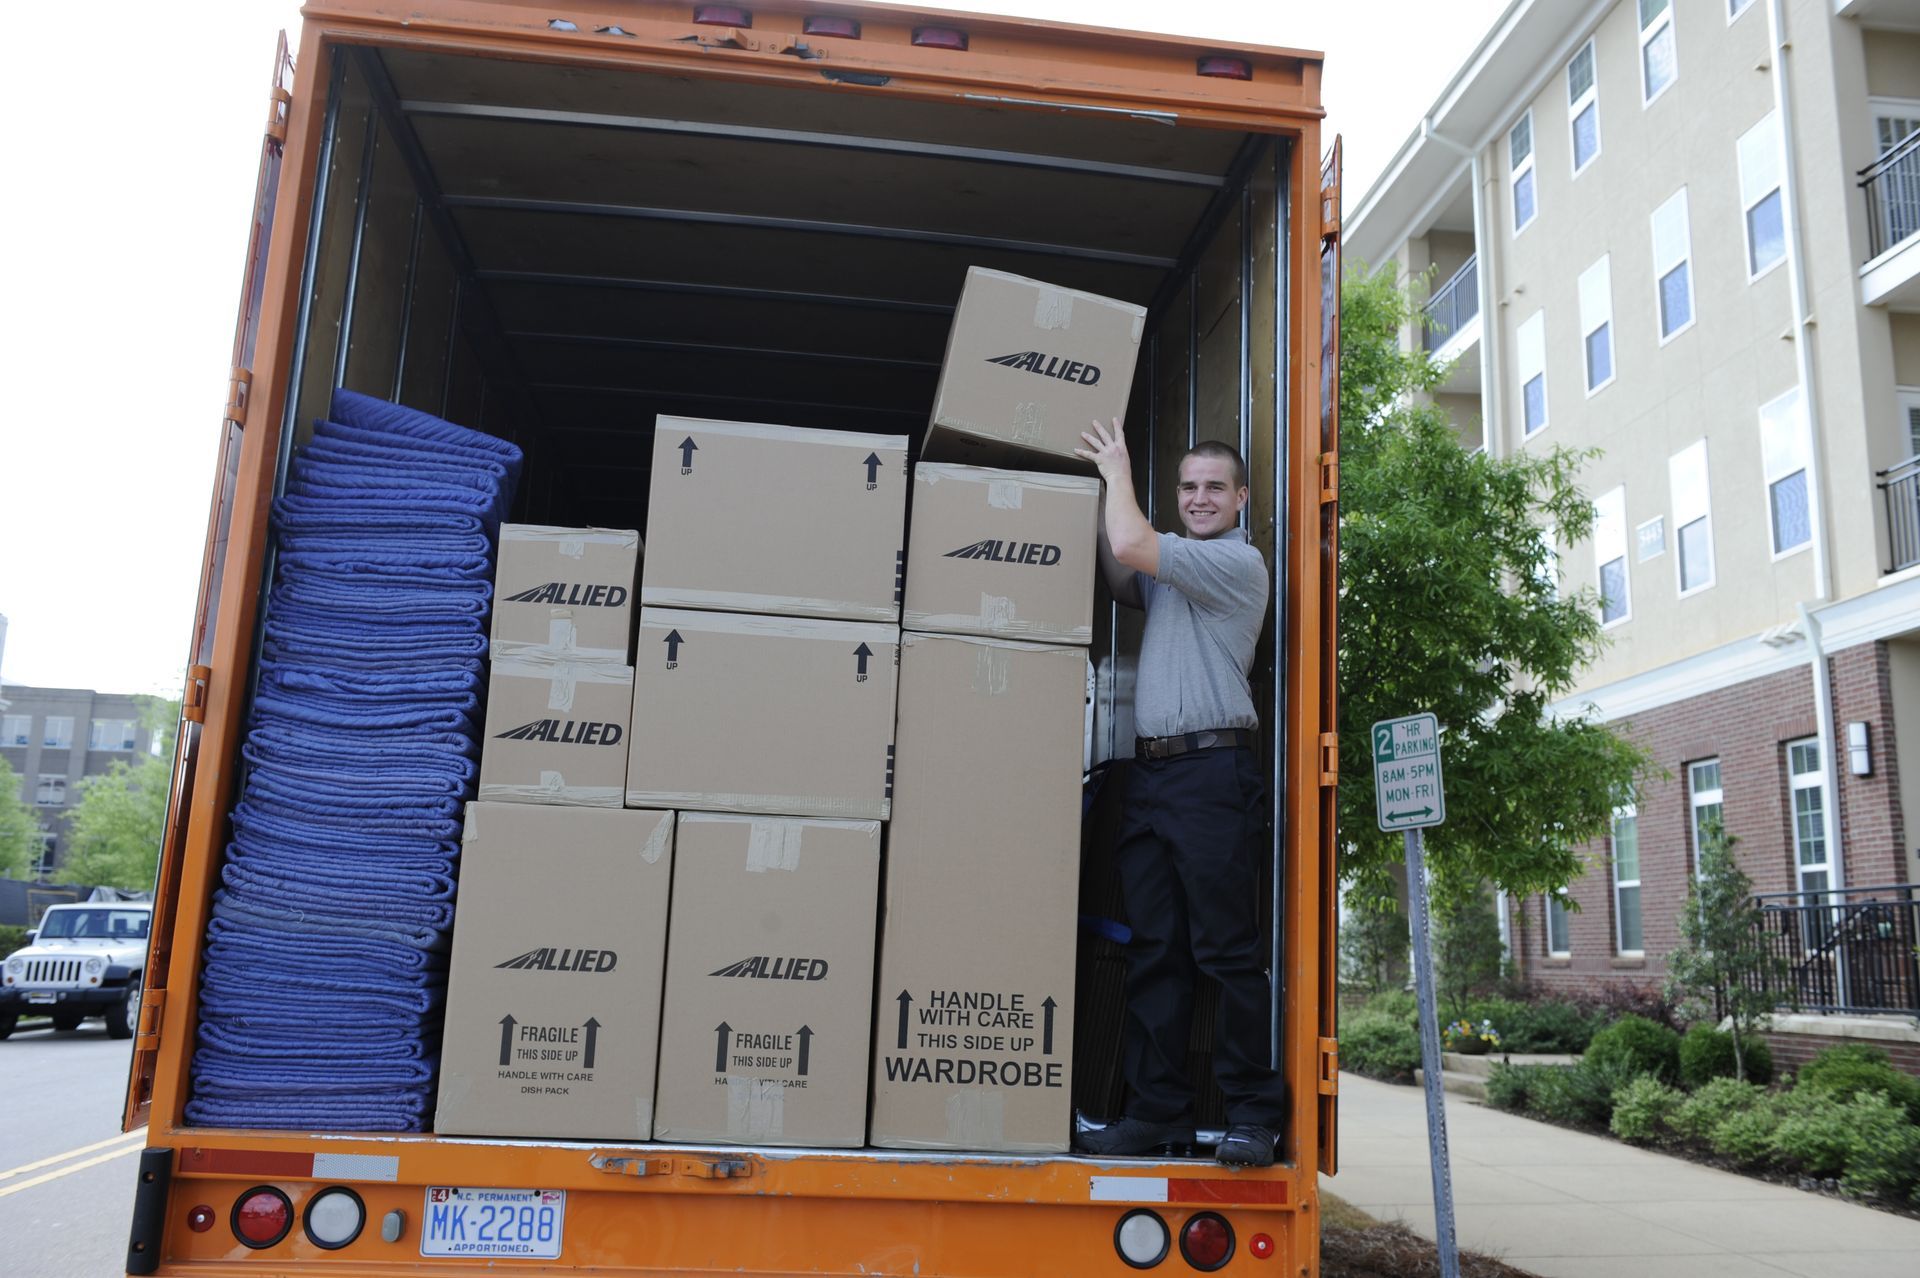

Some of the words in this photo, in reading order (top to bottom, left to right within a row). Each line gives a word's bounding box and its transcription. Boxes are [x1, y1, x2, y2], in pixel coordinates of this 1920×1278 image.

[1013, 351, 1101, 386] ALLIED
[681, 468, 693, 476] UP
[972, 539, 1061, 566] ALLIED
[536, 583, 627, 607] ALLIED
[665, 662, 678, 670] UP
[855, 675, 868, 683] UP
[530, 719, 623, 746] ALLIED
[1406, 723, 1421, 737] HR
[1377, 729, 1392, 756] 2
[1395, 737, 1434, 756] PARKING
[525, 948, 617, 973] ALLIED
[738, 956, 829, 981] ALLIED
[930, 990, 1025, 1012] HANDLE
[919, 1009, 970, 1026] WITH
[977, 1011, 1034, 1029] CARE
[521, 1026, 579, 1043] FRAGILE
[736, 1033, 792, 1050] FRAGILE
[917, 1033, 957, 1049] THIS
[963, 1035, 1004, 1051] SIDE
[1011, 1037, 1034, 1052] UP
[517, 1049, 538, 1060] THIS
[541, 1049, 563, 1061] SIDE
[565, 1050, 578, 1061] UP
[732, 1055, 753, 1067] THIS
[756, 1056, 777, 1068] SIDE
[780, 1057, 792, 1068] UP
[498, 1070, 537, 1080] HANDLE
[540, 1072, 564, 1081] WITH
[566, 1073, 594, 1081] CARE
[885, 1056, 1063, 1088] WARDROBE
[521, 1086, 542, 1094] DISH
[545, 1087, 570, 1095] PACK
[783, 1080, 807, 1088] CARE
[438, 1190, 447, 1201] 4
[478, 1193, 533, 1202] PERMANENT
[430, 1204, 554, 1242] MK-2288
[454, 1243, 529, 1253] APPORTIONED
